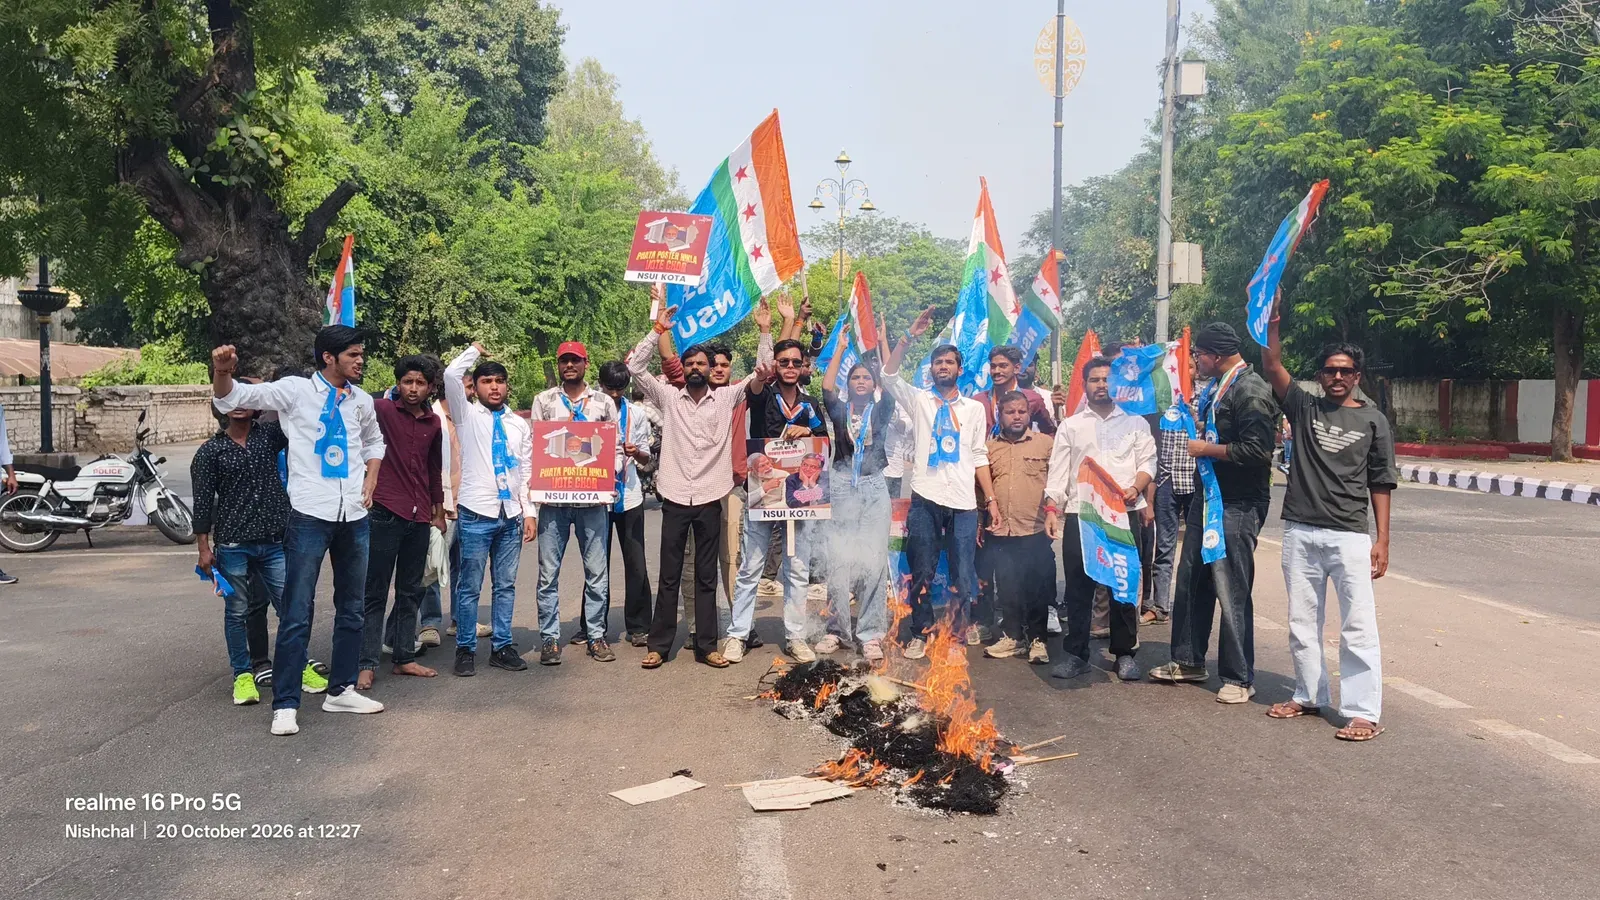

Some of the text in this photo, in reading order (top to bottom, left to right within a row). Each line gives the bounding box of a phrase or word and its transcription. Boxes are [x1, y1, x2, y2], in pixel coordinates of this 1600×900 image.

[636, 251, 698, 264] PHATA POSTER NIKLA
[645, 260, 687, 272] VOTE CHOR
[660, 274, 686, 282] KOTA
[540, 466, 608, 478] PHATA POSTER NIKLA
[552, 477, 598, 489] VOTE CHOR
